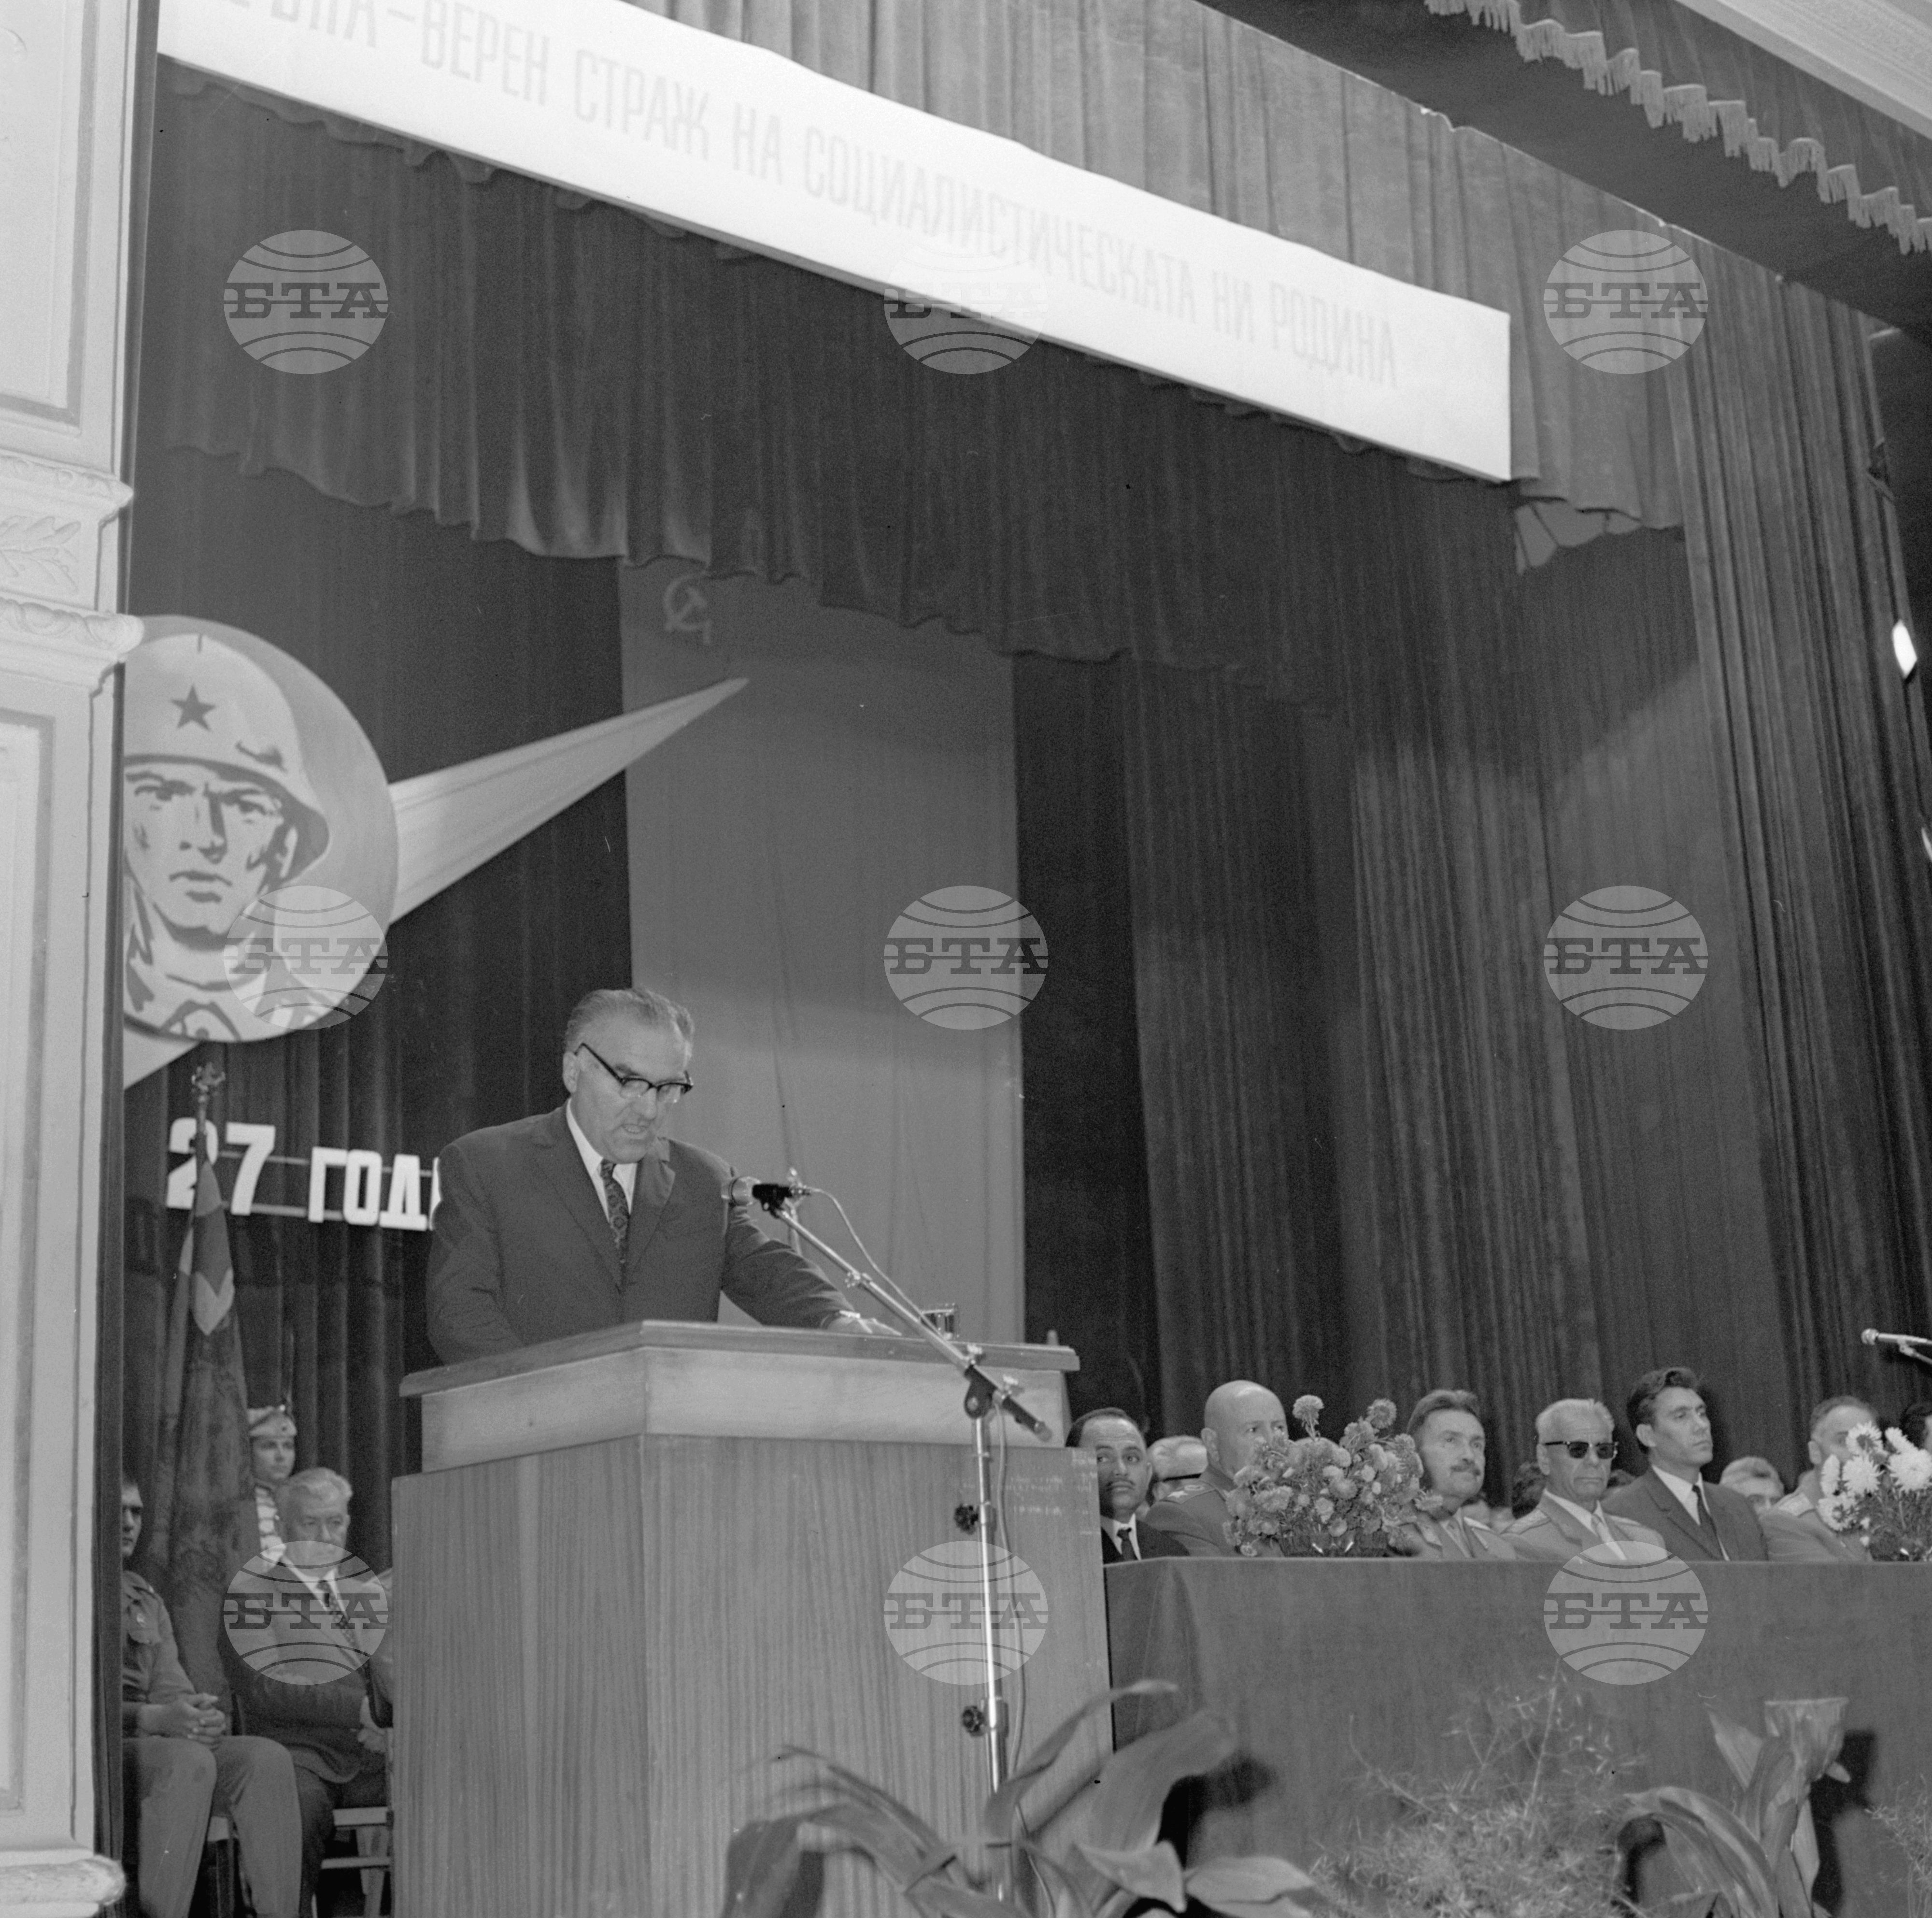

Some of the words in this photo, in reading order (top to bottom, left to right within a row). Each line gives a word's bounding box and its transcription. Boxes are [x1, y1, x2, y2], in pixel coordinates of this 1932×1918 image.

[574, 49, 710, 161] СТРАЖ
[732, 102, 783, 186] НА
[805, 126, 1198, 325] СОЦИАЛИСТИЧЕСКАТА
[1211, 270, 1256, 343] НИ
[1268, 280, 1398, 388] РОДИНА
[166, 1116, 276, 1216] 27
[308, 1145, 443, 1232] ГОД
